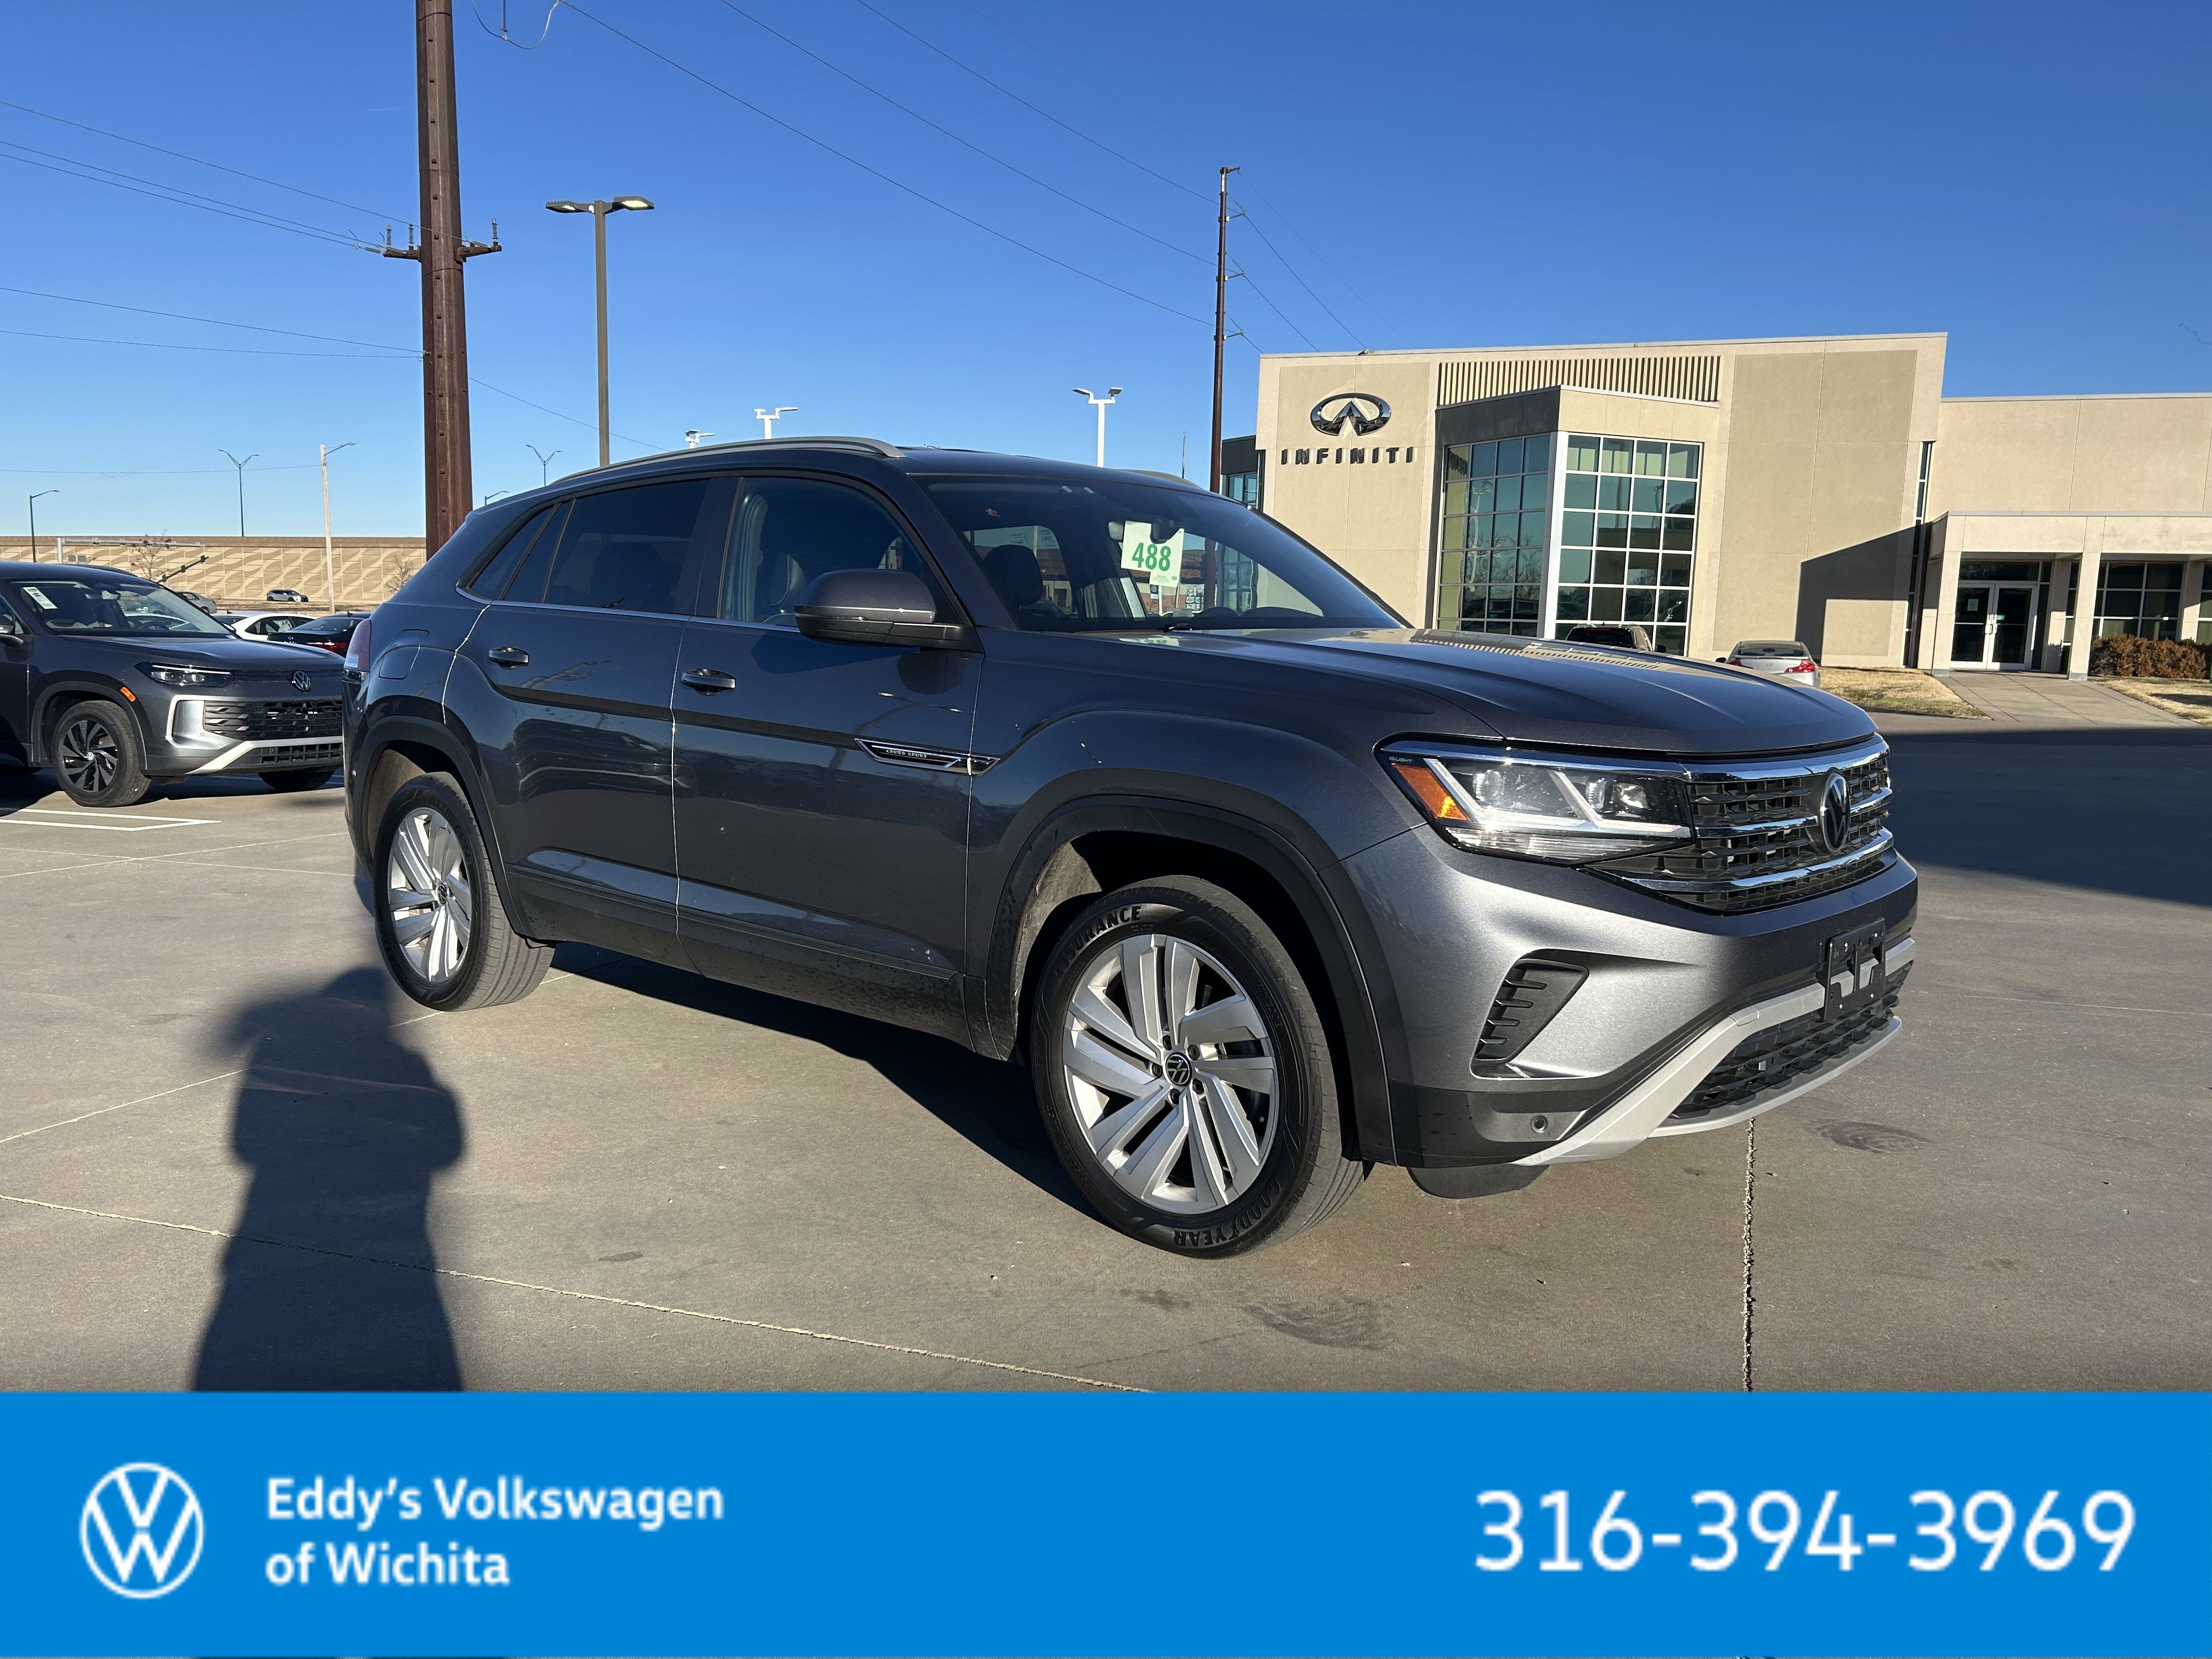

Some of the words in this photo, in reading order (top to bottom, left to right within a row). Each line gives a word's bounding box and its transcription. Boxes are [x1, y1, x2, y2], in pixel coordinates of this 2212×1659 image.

[1281, 447, 1413, 465] INFINITI
[1132, 543, 1171, 572] 488
[294, 671, 311, 690] VW
[1052, 905, 1141, 983] ASSURANCE
[1173, 1178, 1282, 1246] GOODYEAR
